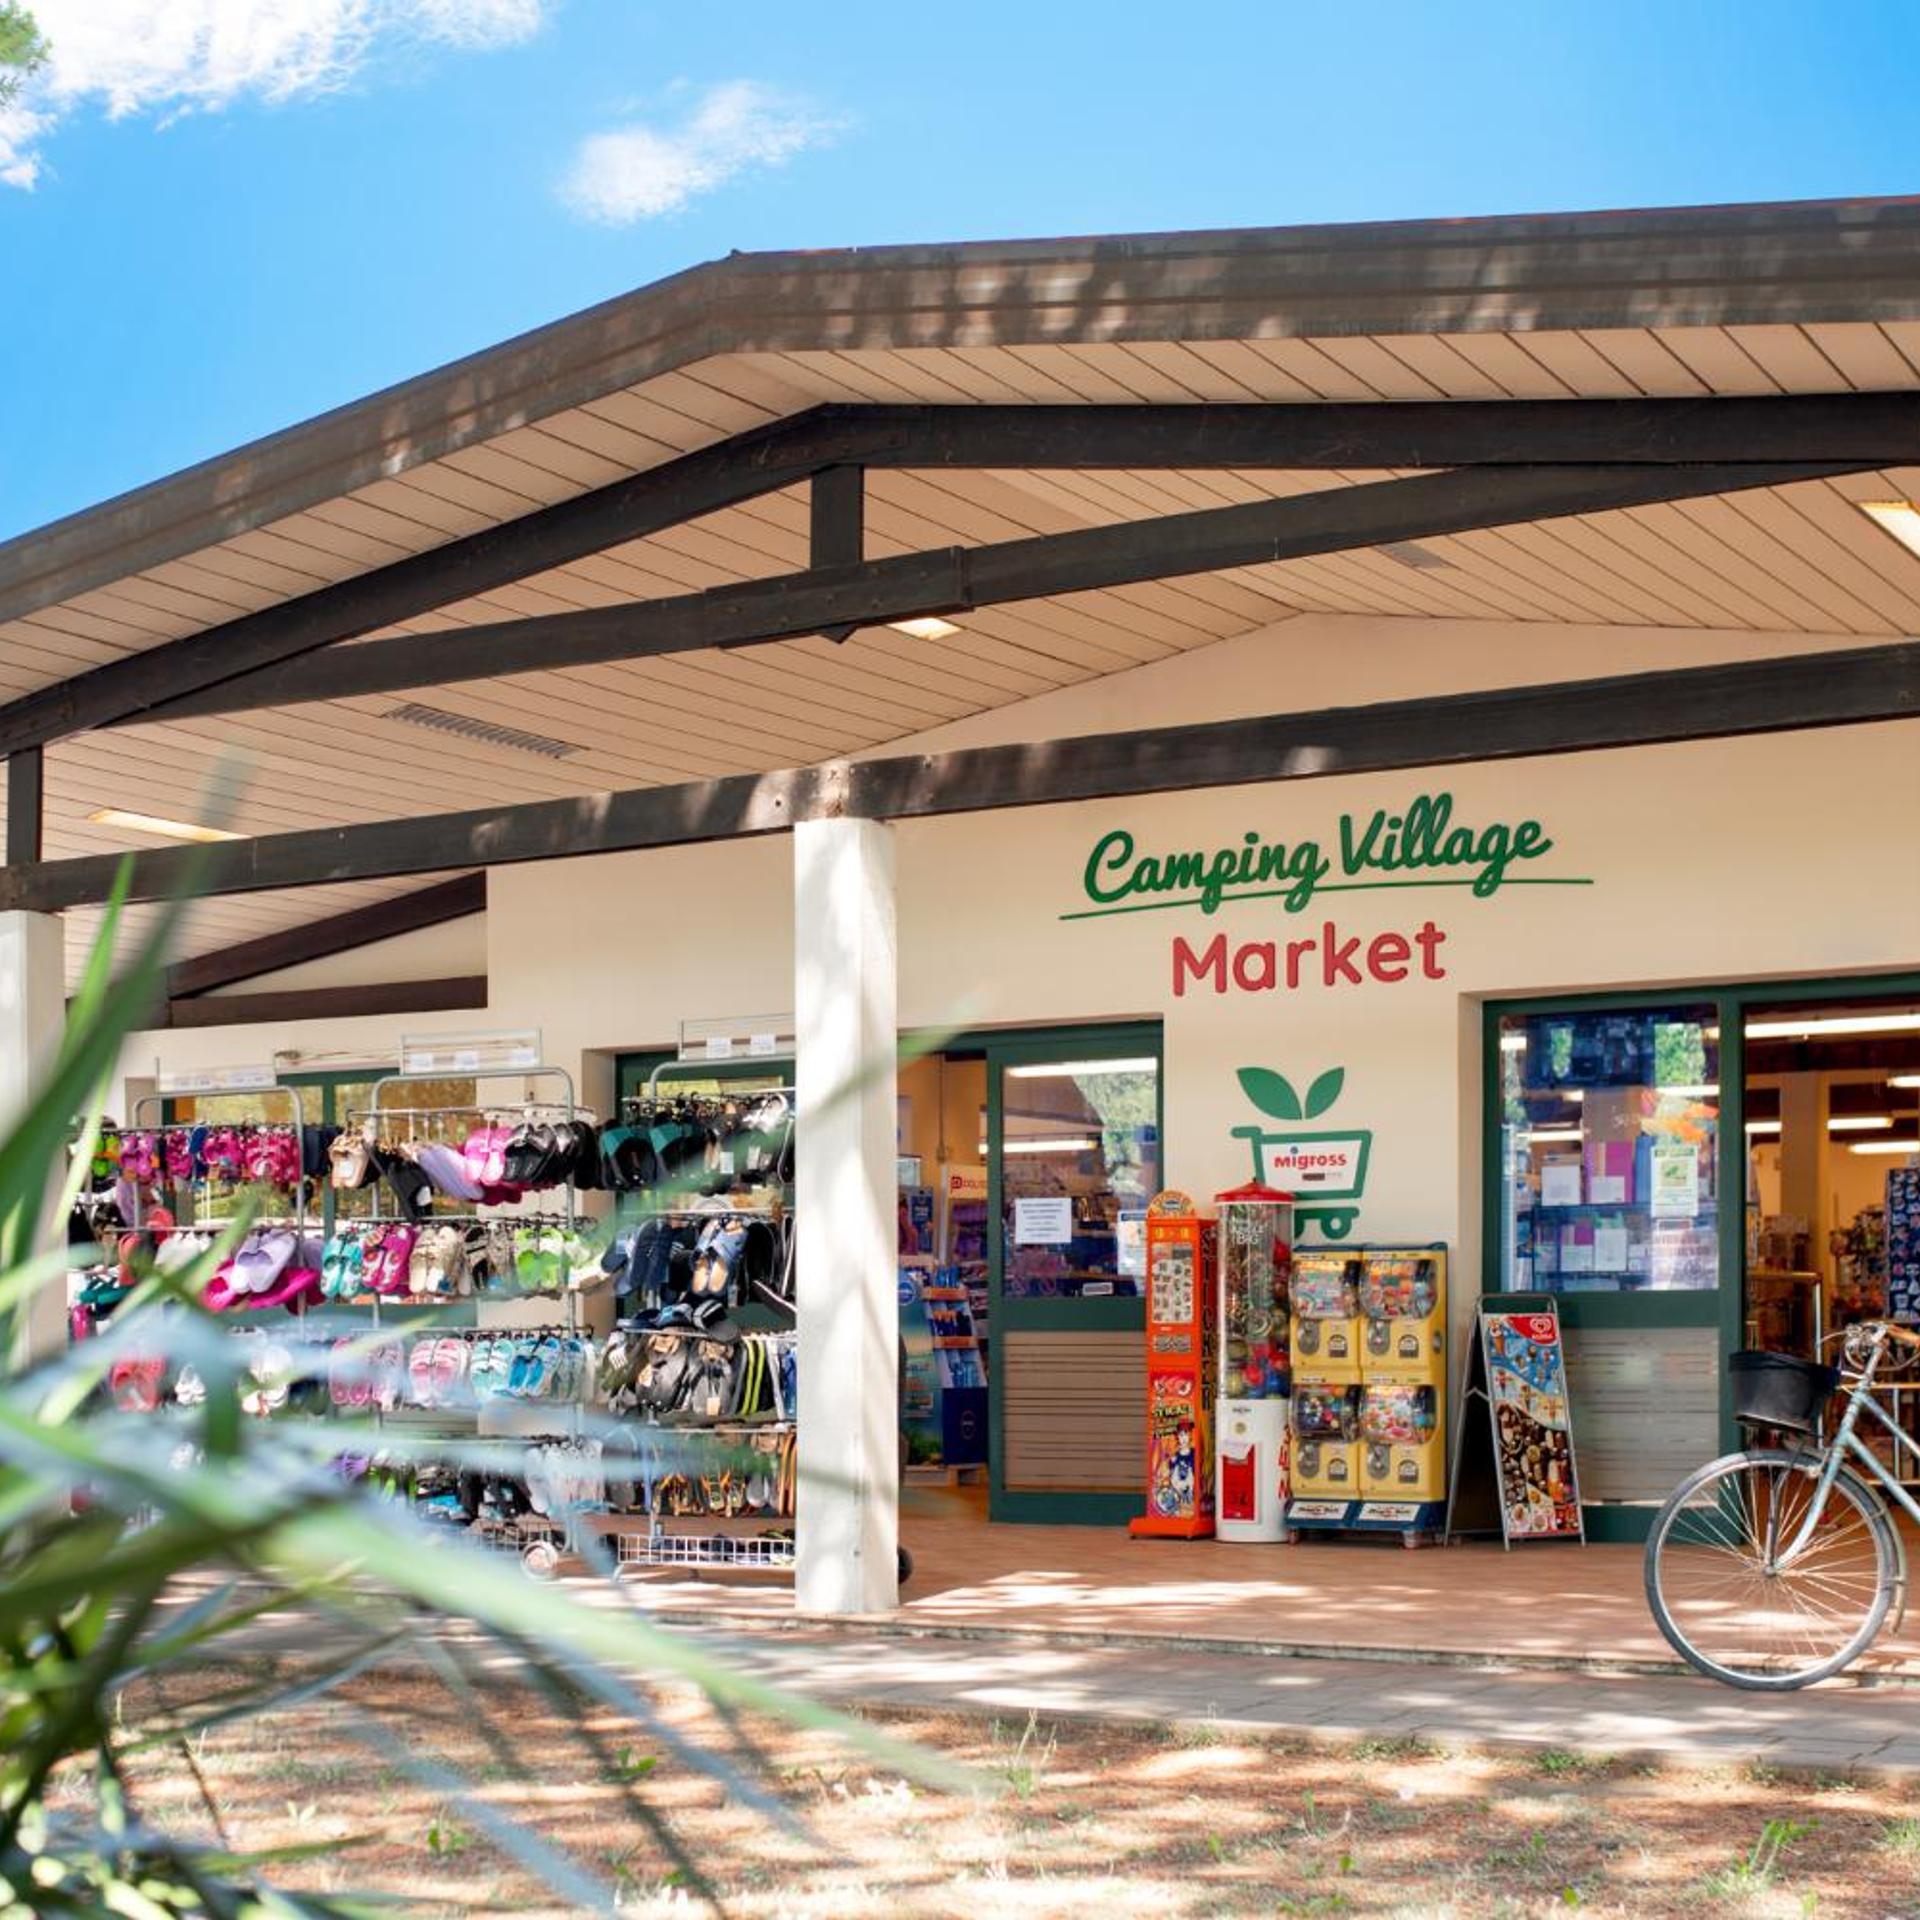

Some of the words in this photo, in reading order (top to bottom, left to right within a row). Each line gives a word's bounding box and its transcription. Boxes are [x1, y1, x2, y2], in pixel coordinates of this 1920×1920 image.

[1085, 831, 1329, 914] Camping
[1339, 793, 1552, 898] Village
[1172, 921, 1447, 996] Market
